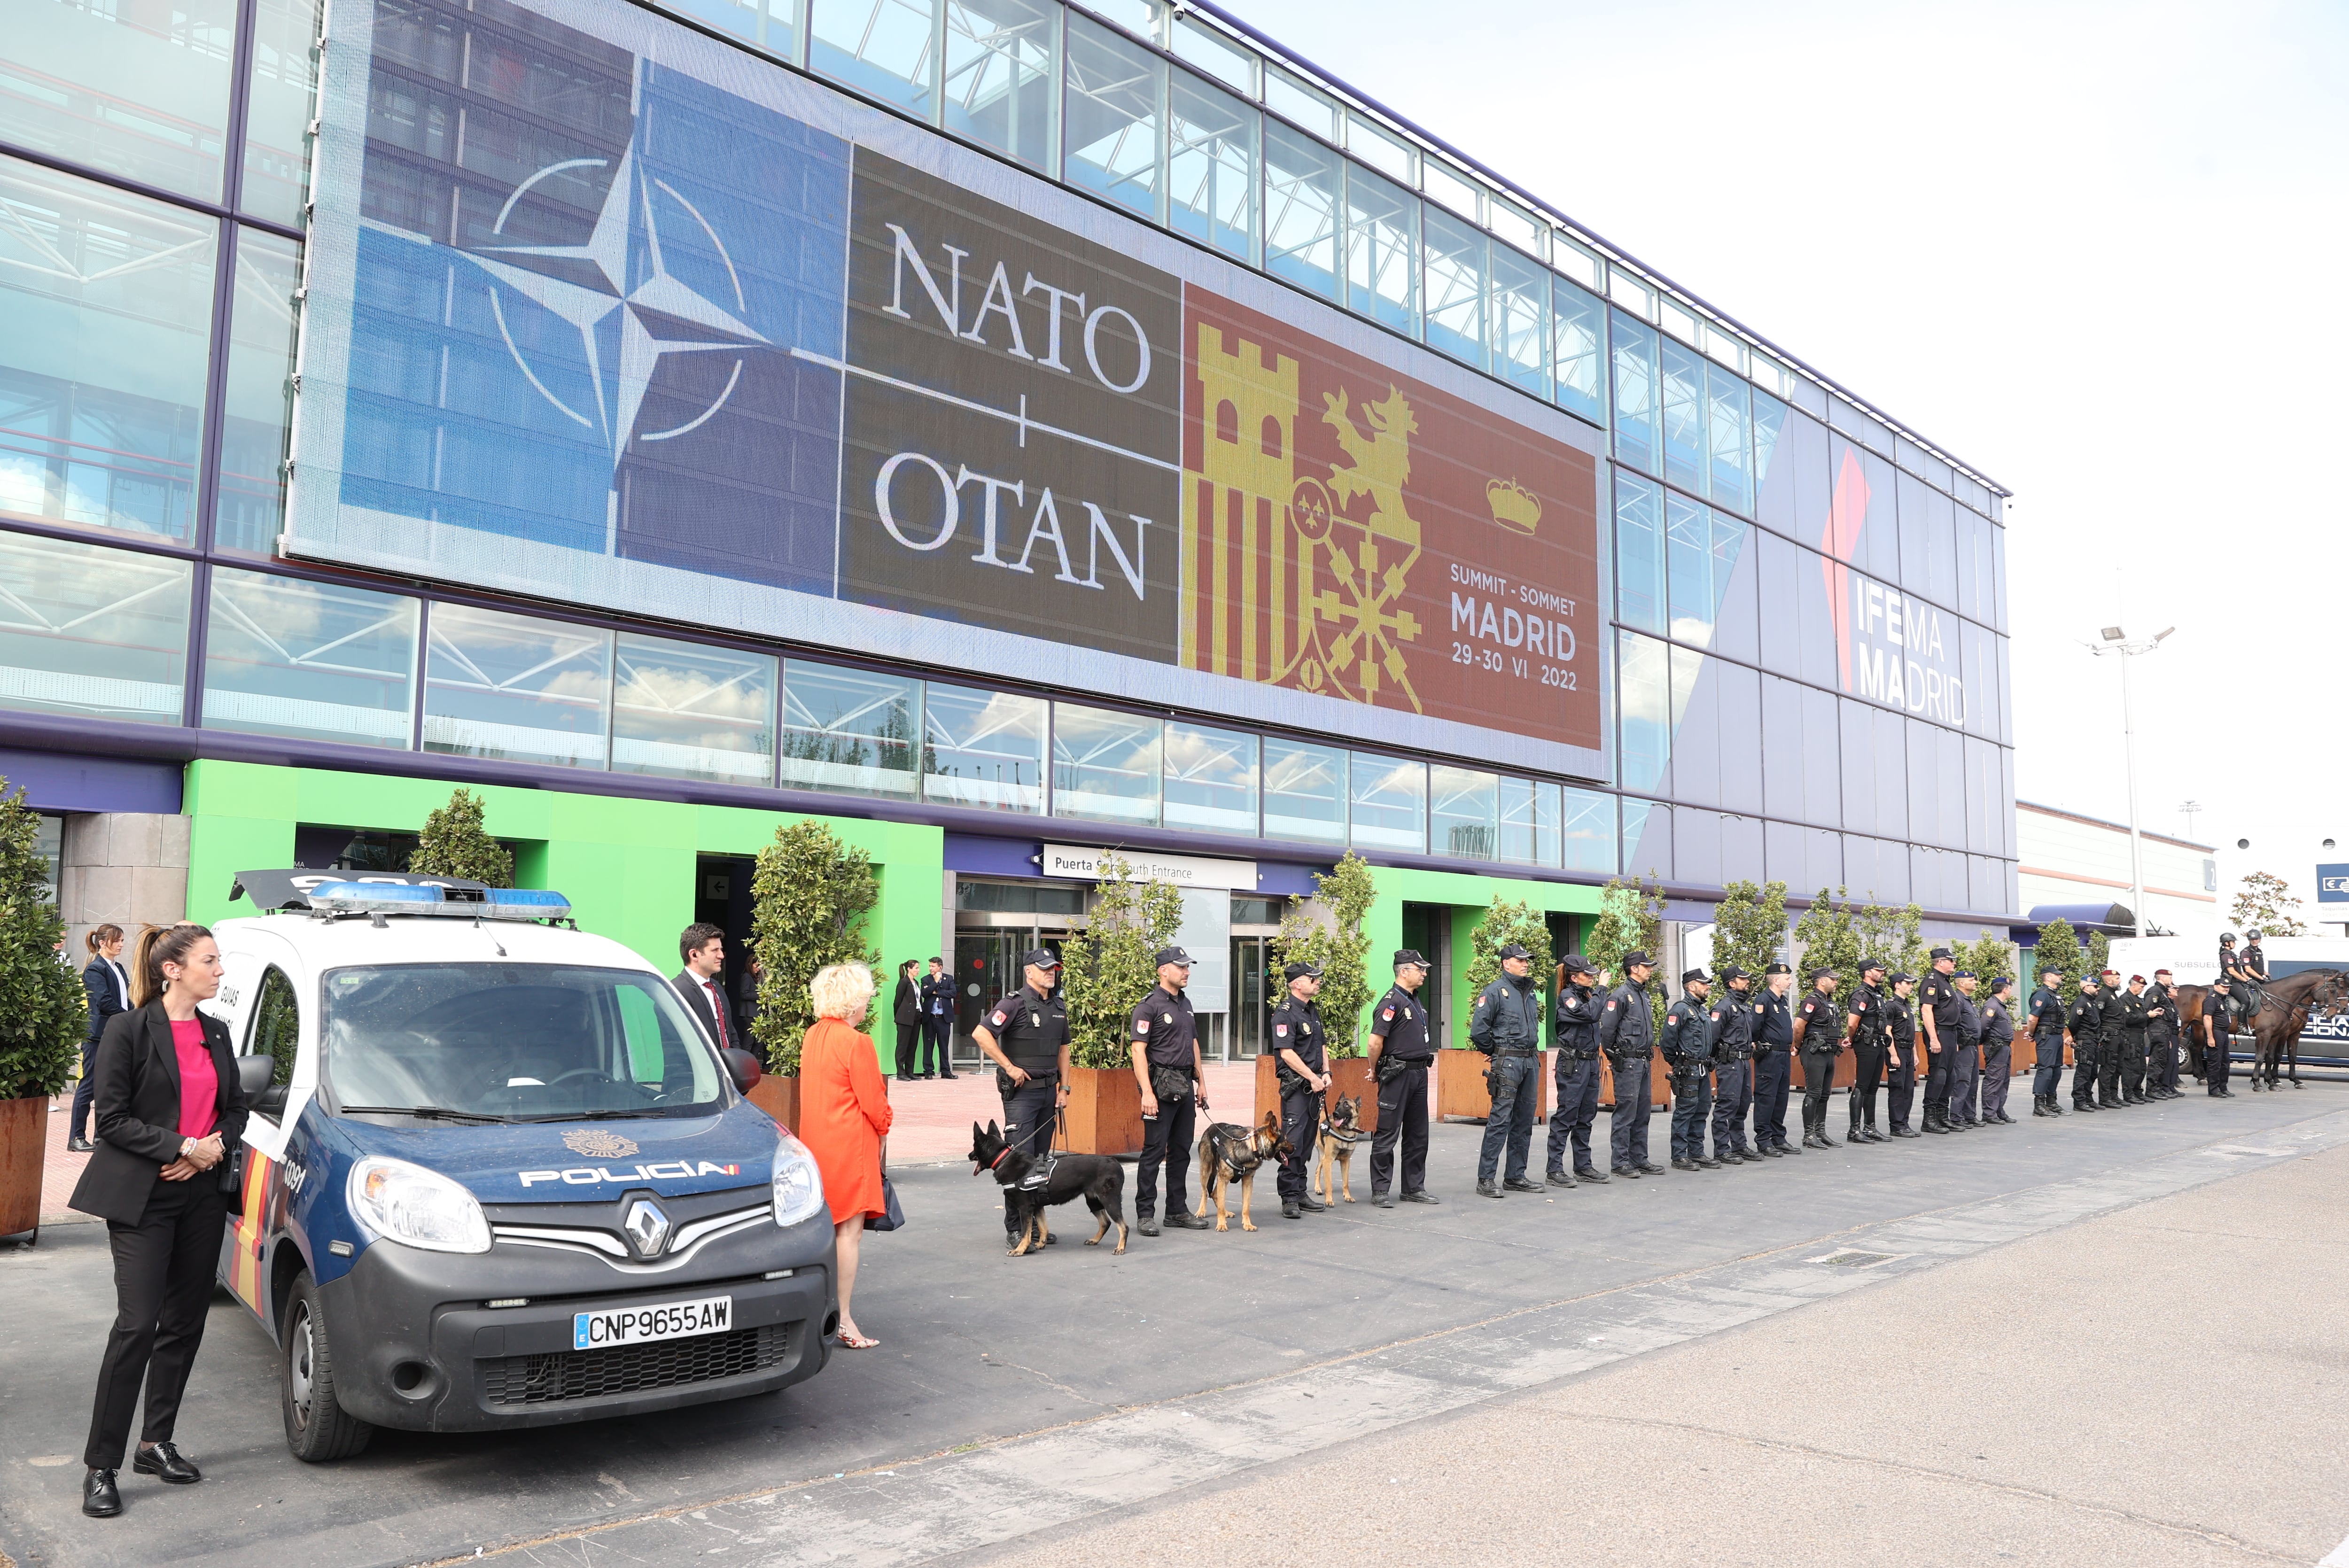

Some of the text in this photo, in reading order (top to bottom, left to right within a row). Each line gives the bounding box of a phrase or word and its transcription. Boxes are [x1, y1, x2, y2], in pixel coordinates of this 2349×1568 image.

[882, 222, 1151, 394] NATO
[875, 452, 1152, 601] OTAN
[1451, 563, 1507, 596] SUMMIT
[1520, 585, 1576, 617] SOMMET
[1857, 577, 1945, 662] IFEMA
[1452, 591, 1576, 662] MADRID
[1452, 642, 1577, 691] 29-30 VI 2022
[1859, 642, 1967, 726] MADRID
[1055, 857, 1092, 870] Puerta
[1127, 863, 1148, 875] outh
[1152, 865, 1192, 878] Entrance
[2210, 868, 2216, 886] 2
